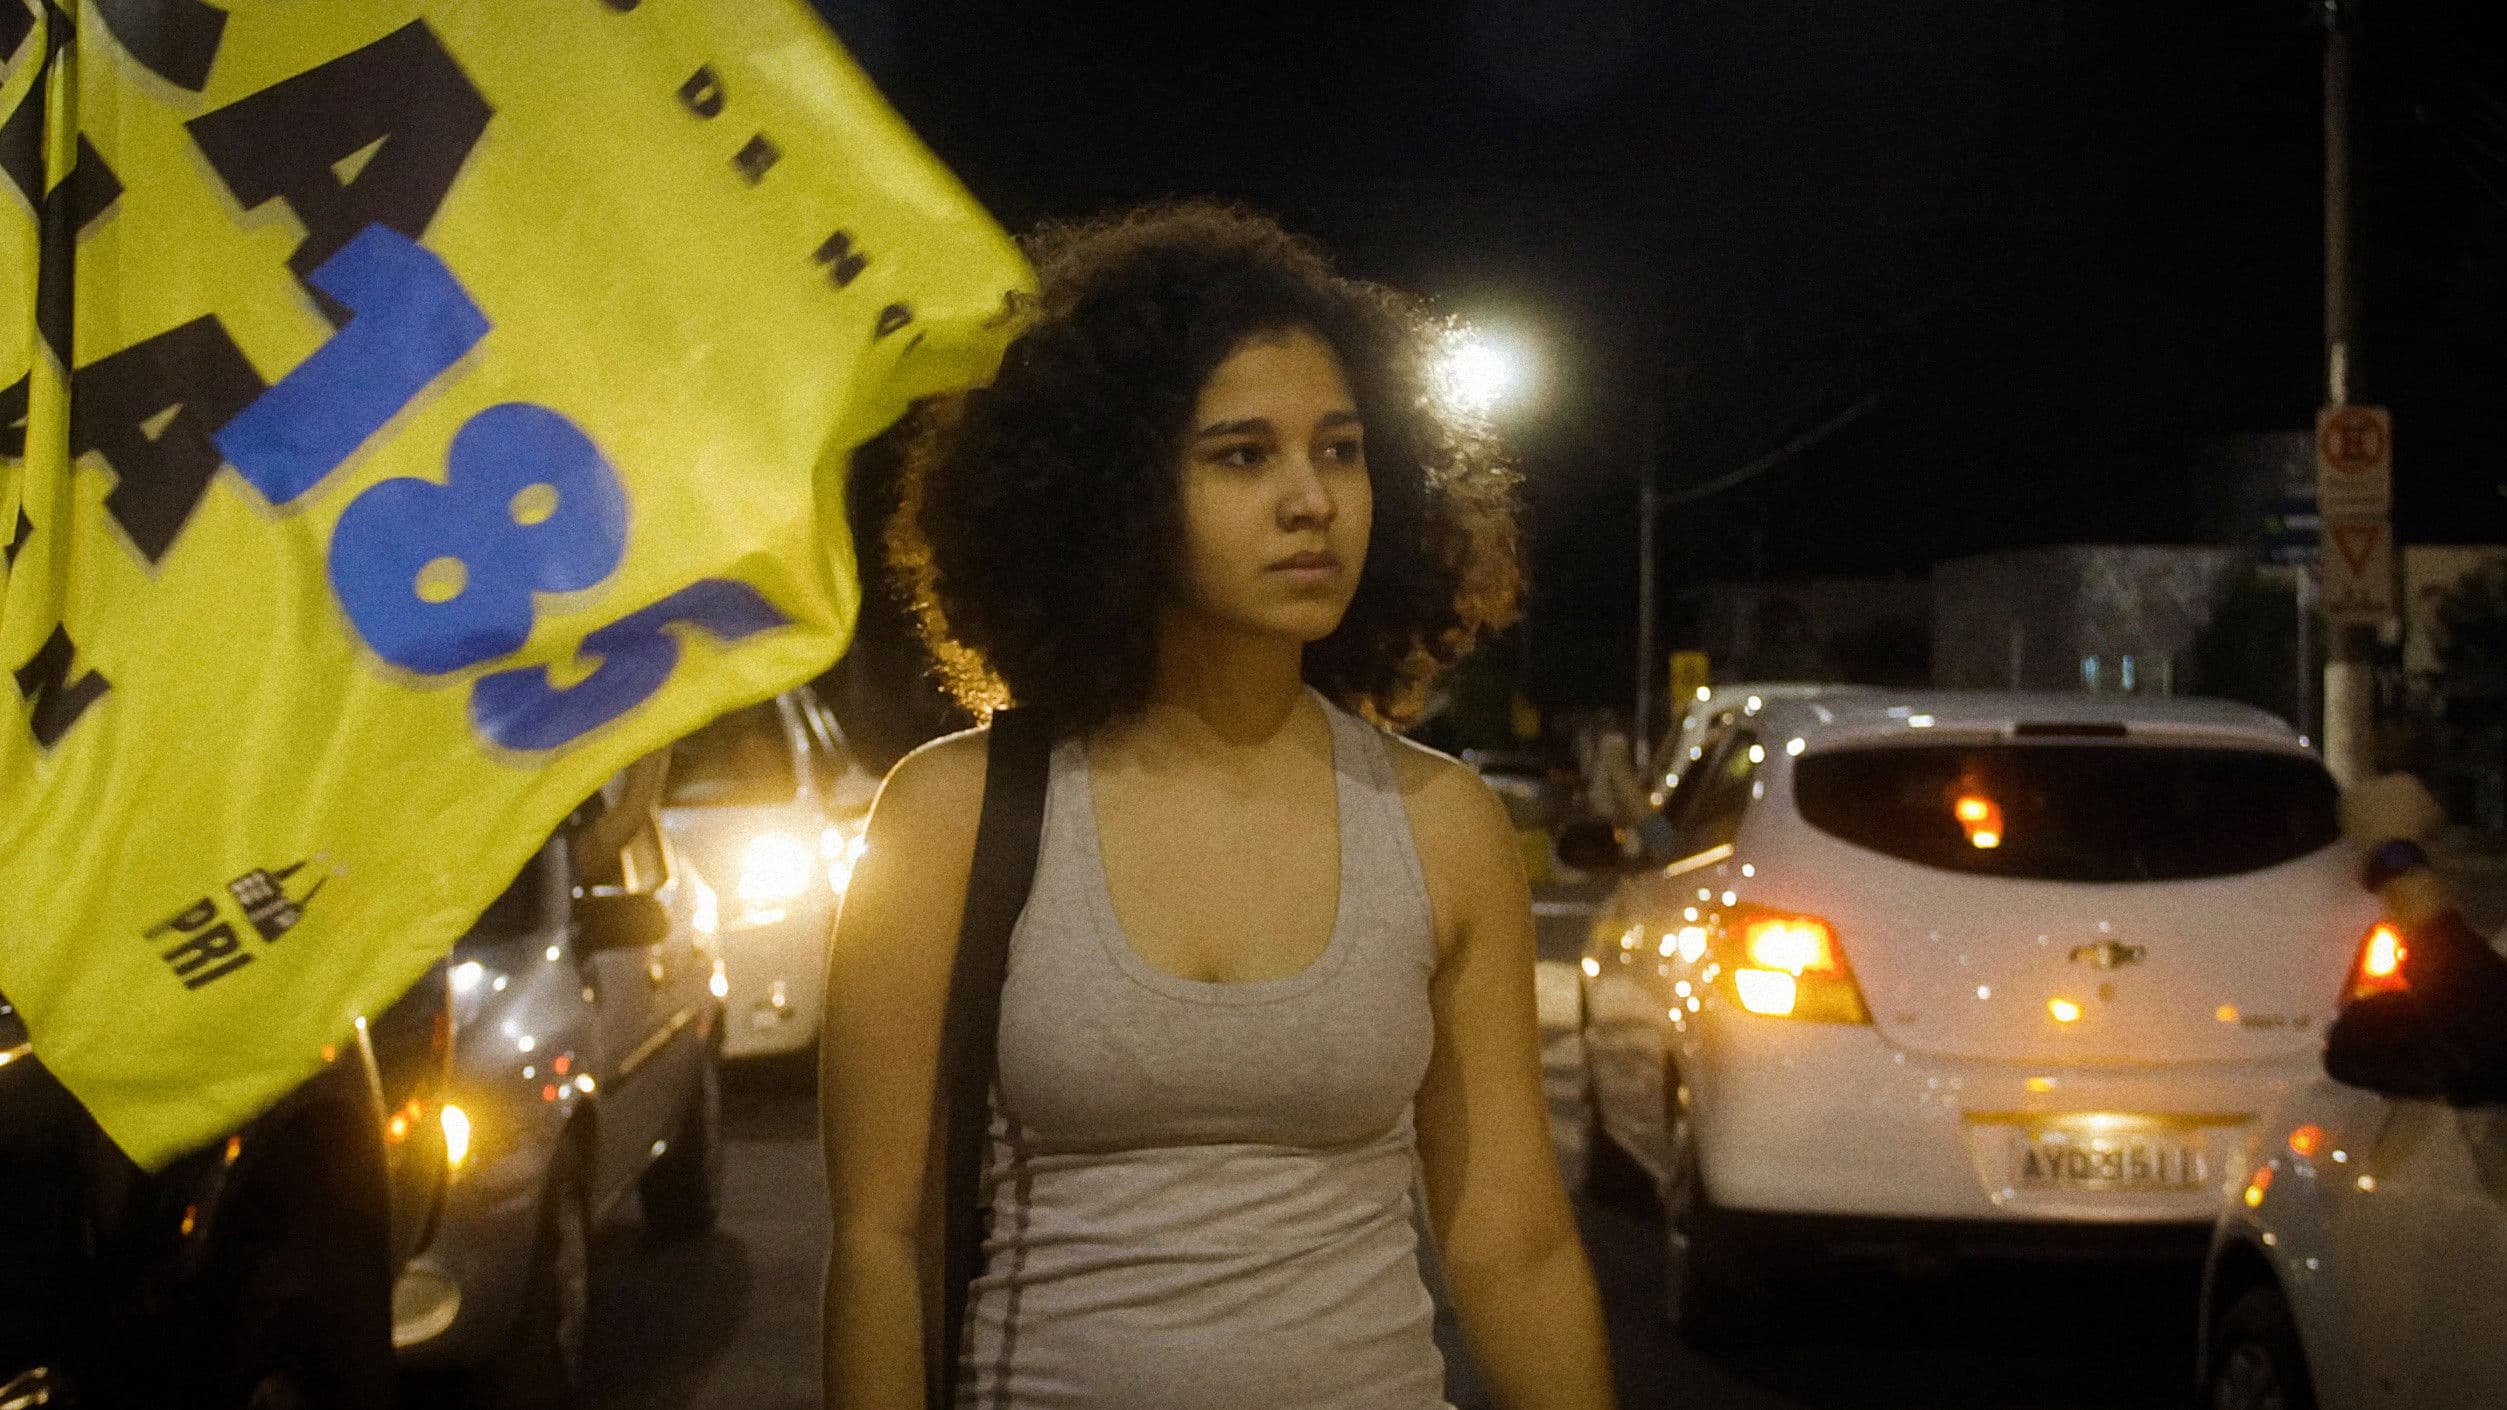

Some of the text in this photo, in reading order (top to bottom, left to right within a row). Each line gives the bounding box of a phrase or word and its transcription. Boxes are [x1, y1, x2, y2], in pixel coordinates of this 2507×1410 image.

[677, 64, 782, 186] DE
[211, 221, 796, 751] 185
[143, 897, 254, 991] PRI
